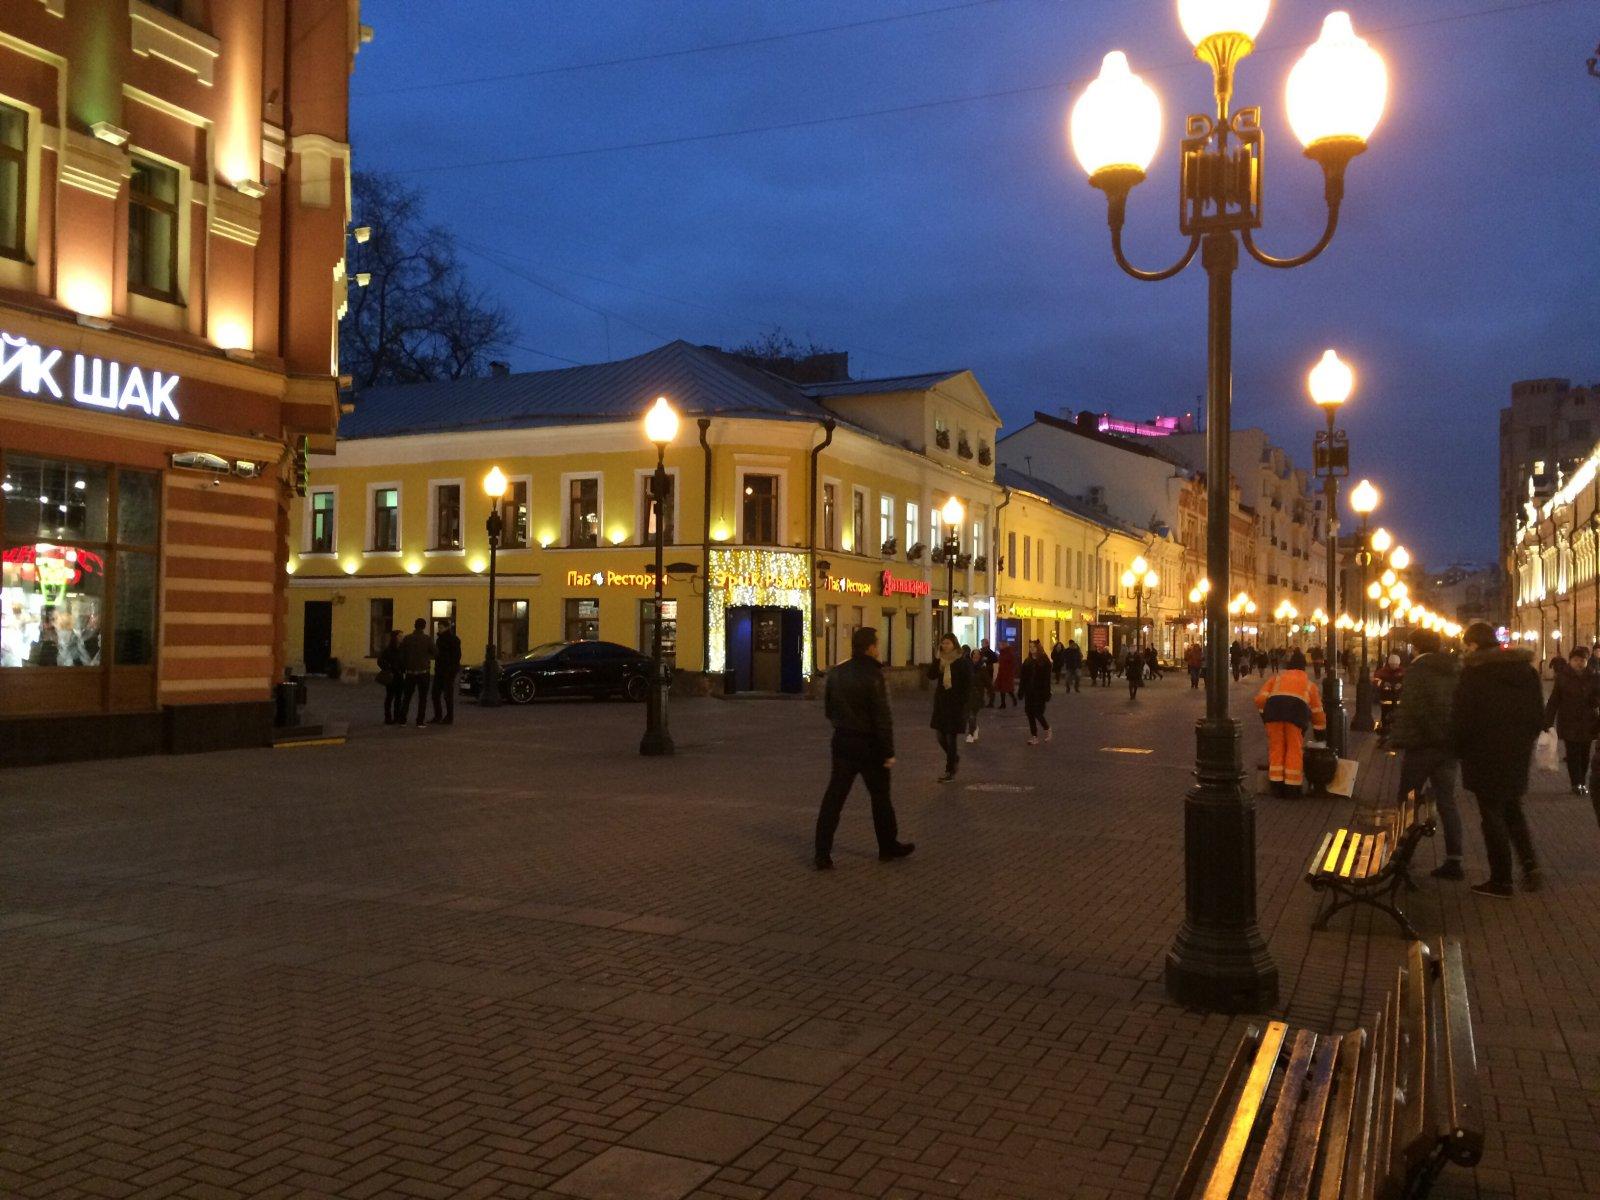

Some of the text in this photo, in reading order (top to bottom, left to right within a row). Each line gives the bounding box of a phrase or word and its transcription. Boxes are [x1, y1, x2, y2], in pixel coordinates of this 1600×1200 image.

[74, 354, 180, 421] ШАК
[567, 570, 592, 586] Паб
[827, 575, 871, 597] Паб Ресторан
